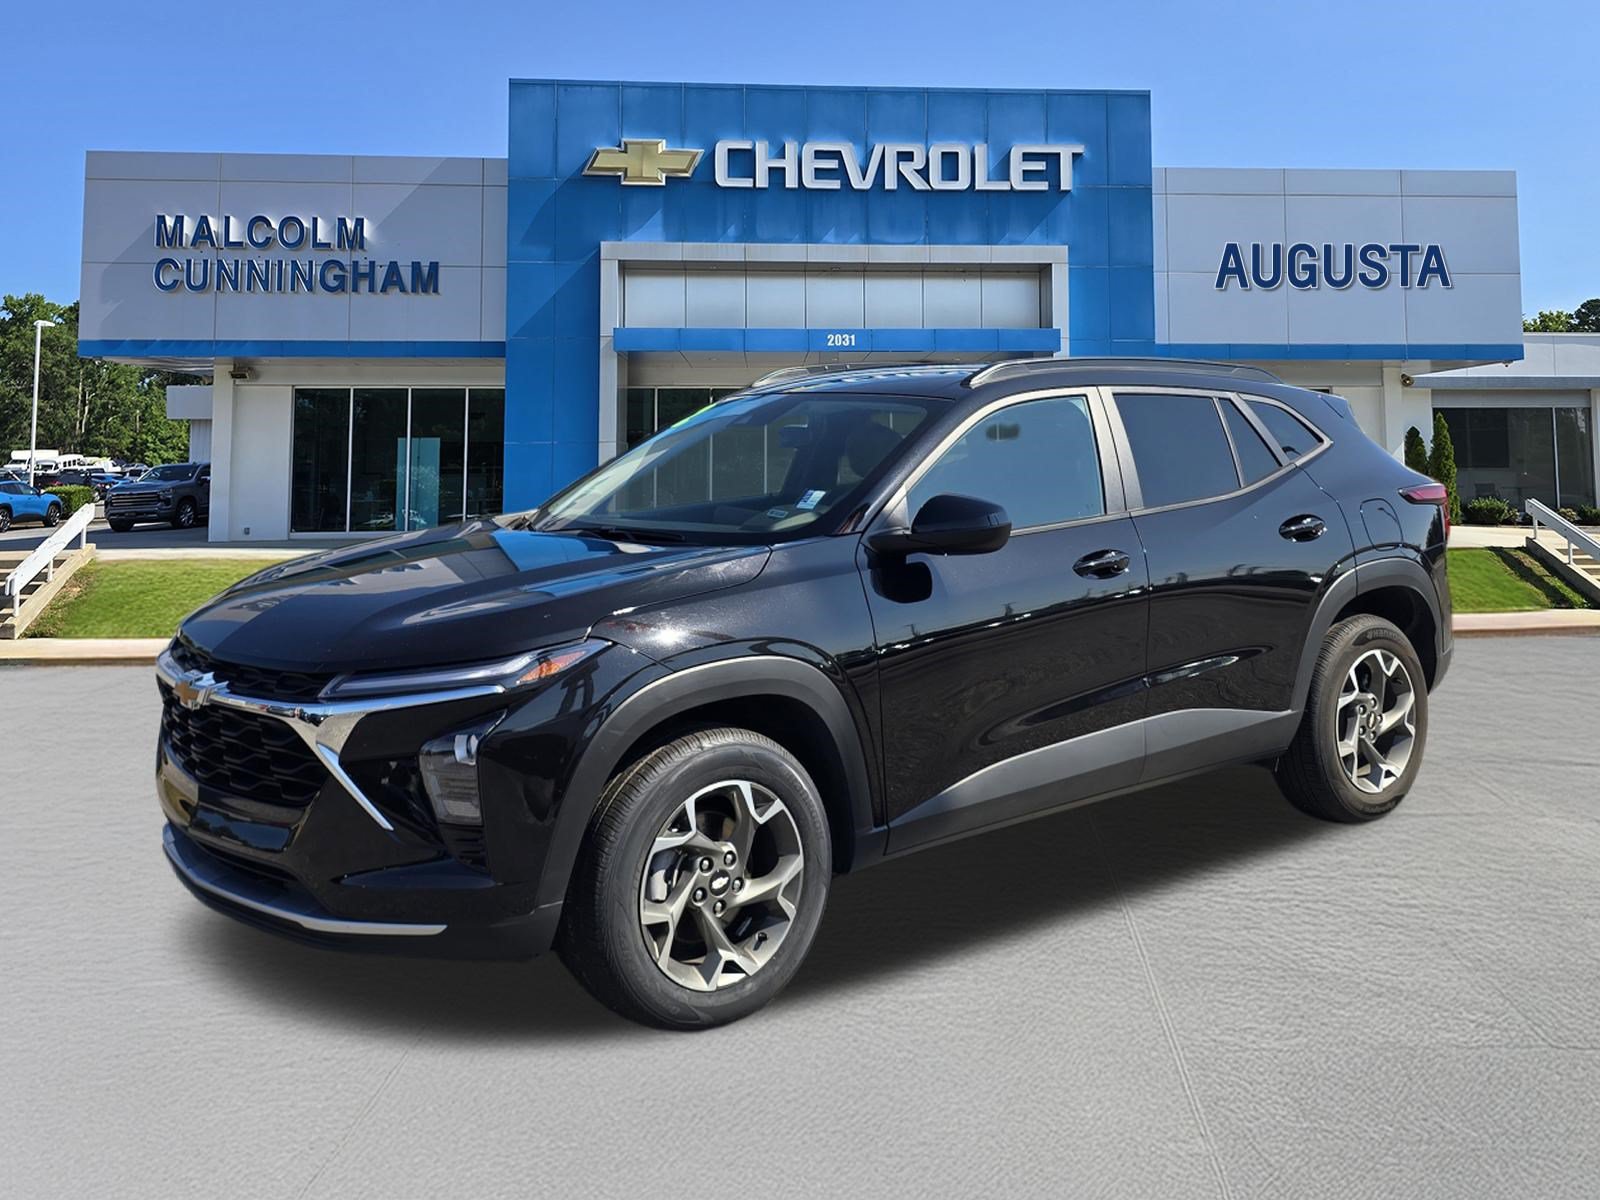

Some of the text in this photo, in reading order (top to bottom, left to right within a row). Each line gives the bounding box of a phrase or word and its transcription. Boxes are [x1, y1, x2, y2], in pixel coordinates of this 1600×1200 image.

[714, 139, 1084, 192] CHEVROLET
[154, 214, 366, 250] MALCOLM
[153, 258, 440, 294] CUNNINGHAM
[1215, 242, 1452, 290] AUGUSTA
[826, 333, 856, 347] 2031
